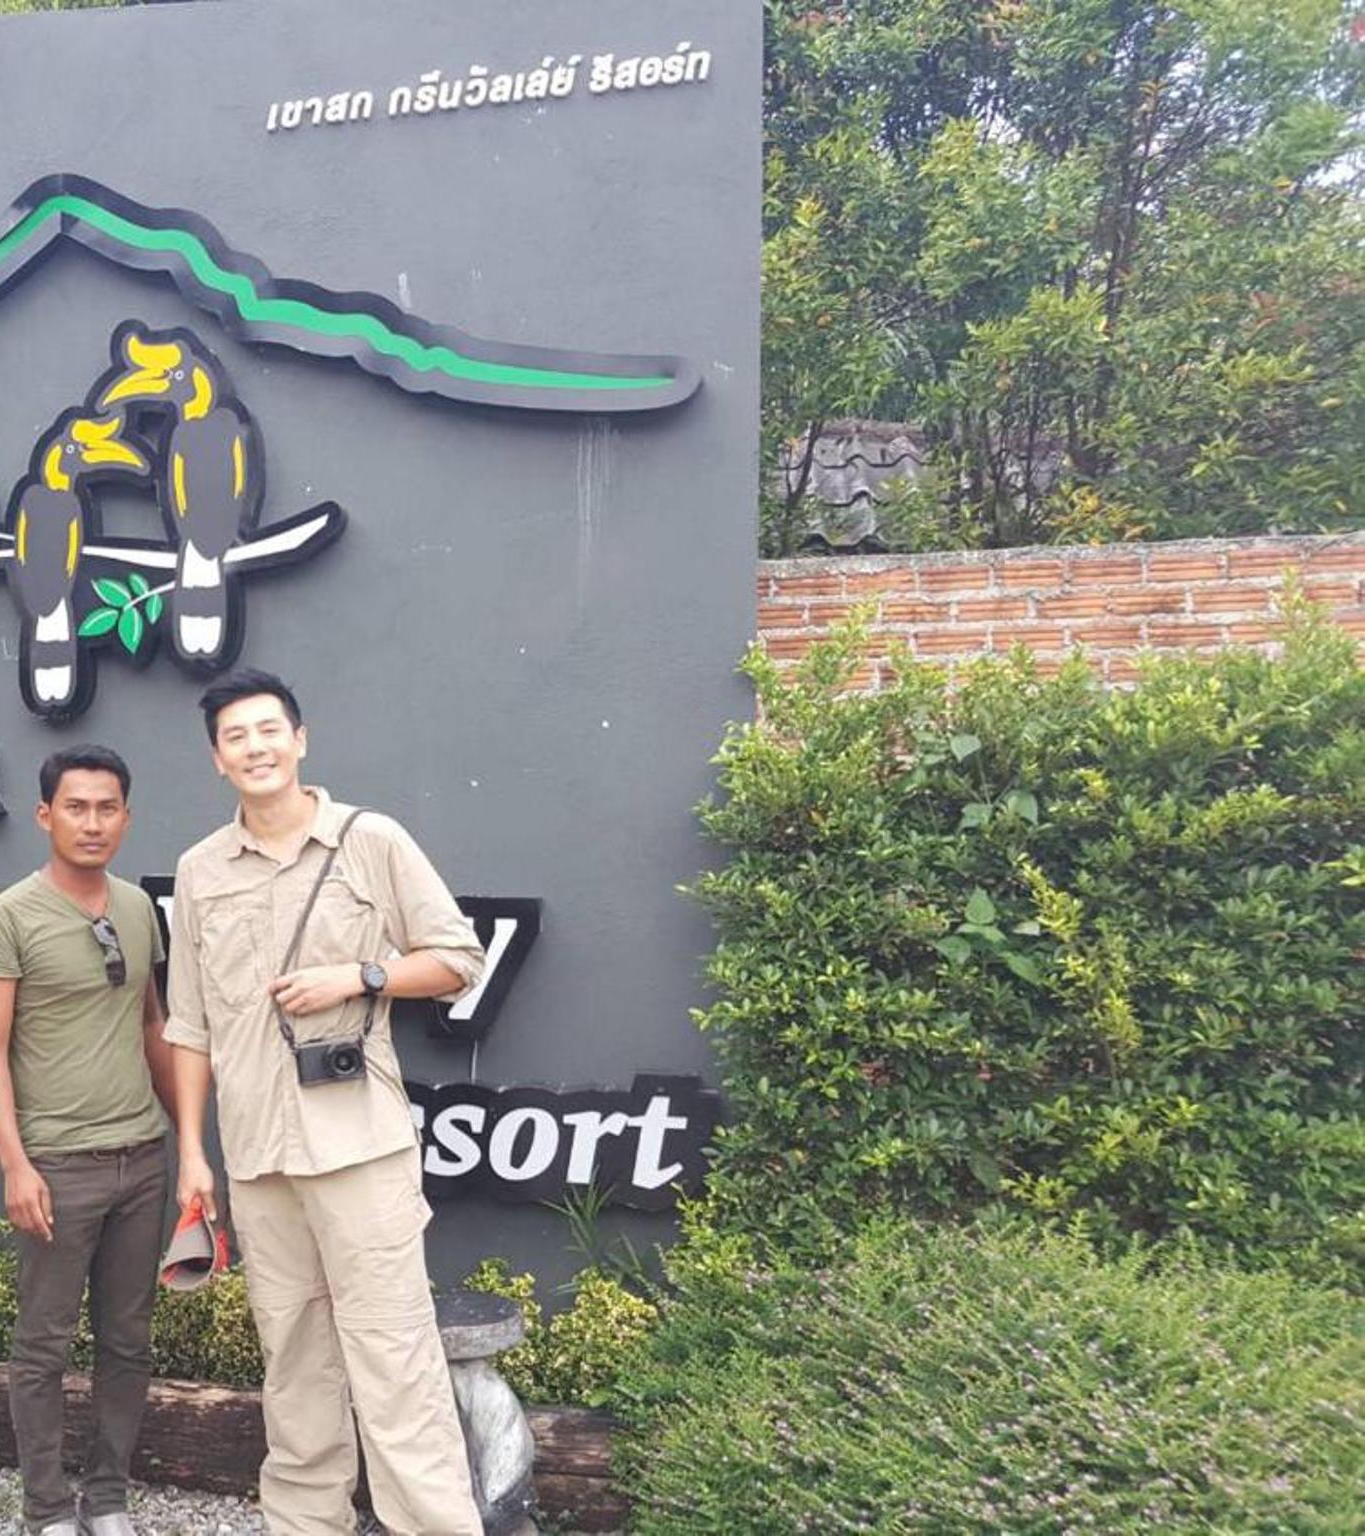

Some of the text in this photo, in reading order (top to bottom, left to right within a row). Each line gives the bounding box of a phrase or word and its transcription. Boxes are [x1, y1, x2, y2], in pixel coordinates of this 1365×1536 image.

[266, 88, 372, 131] เขาสก
[588, 41, 712, 95] รีสอร์ท
